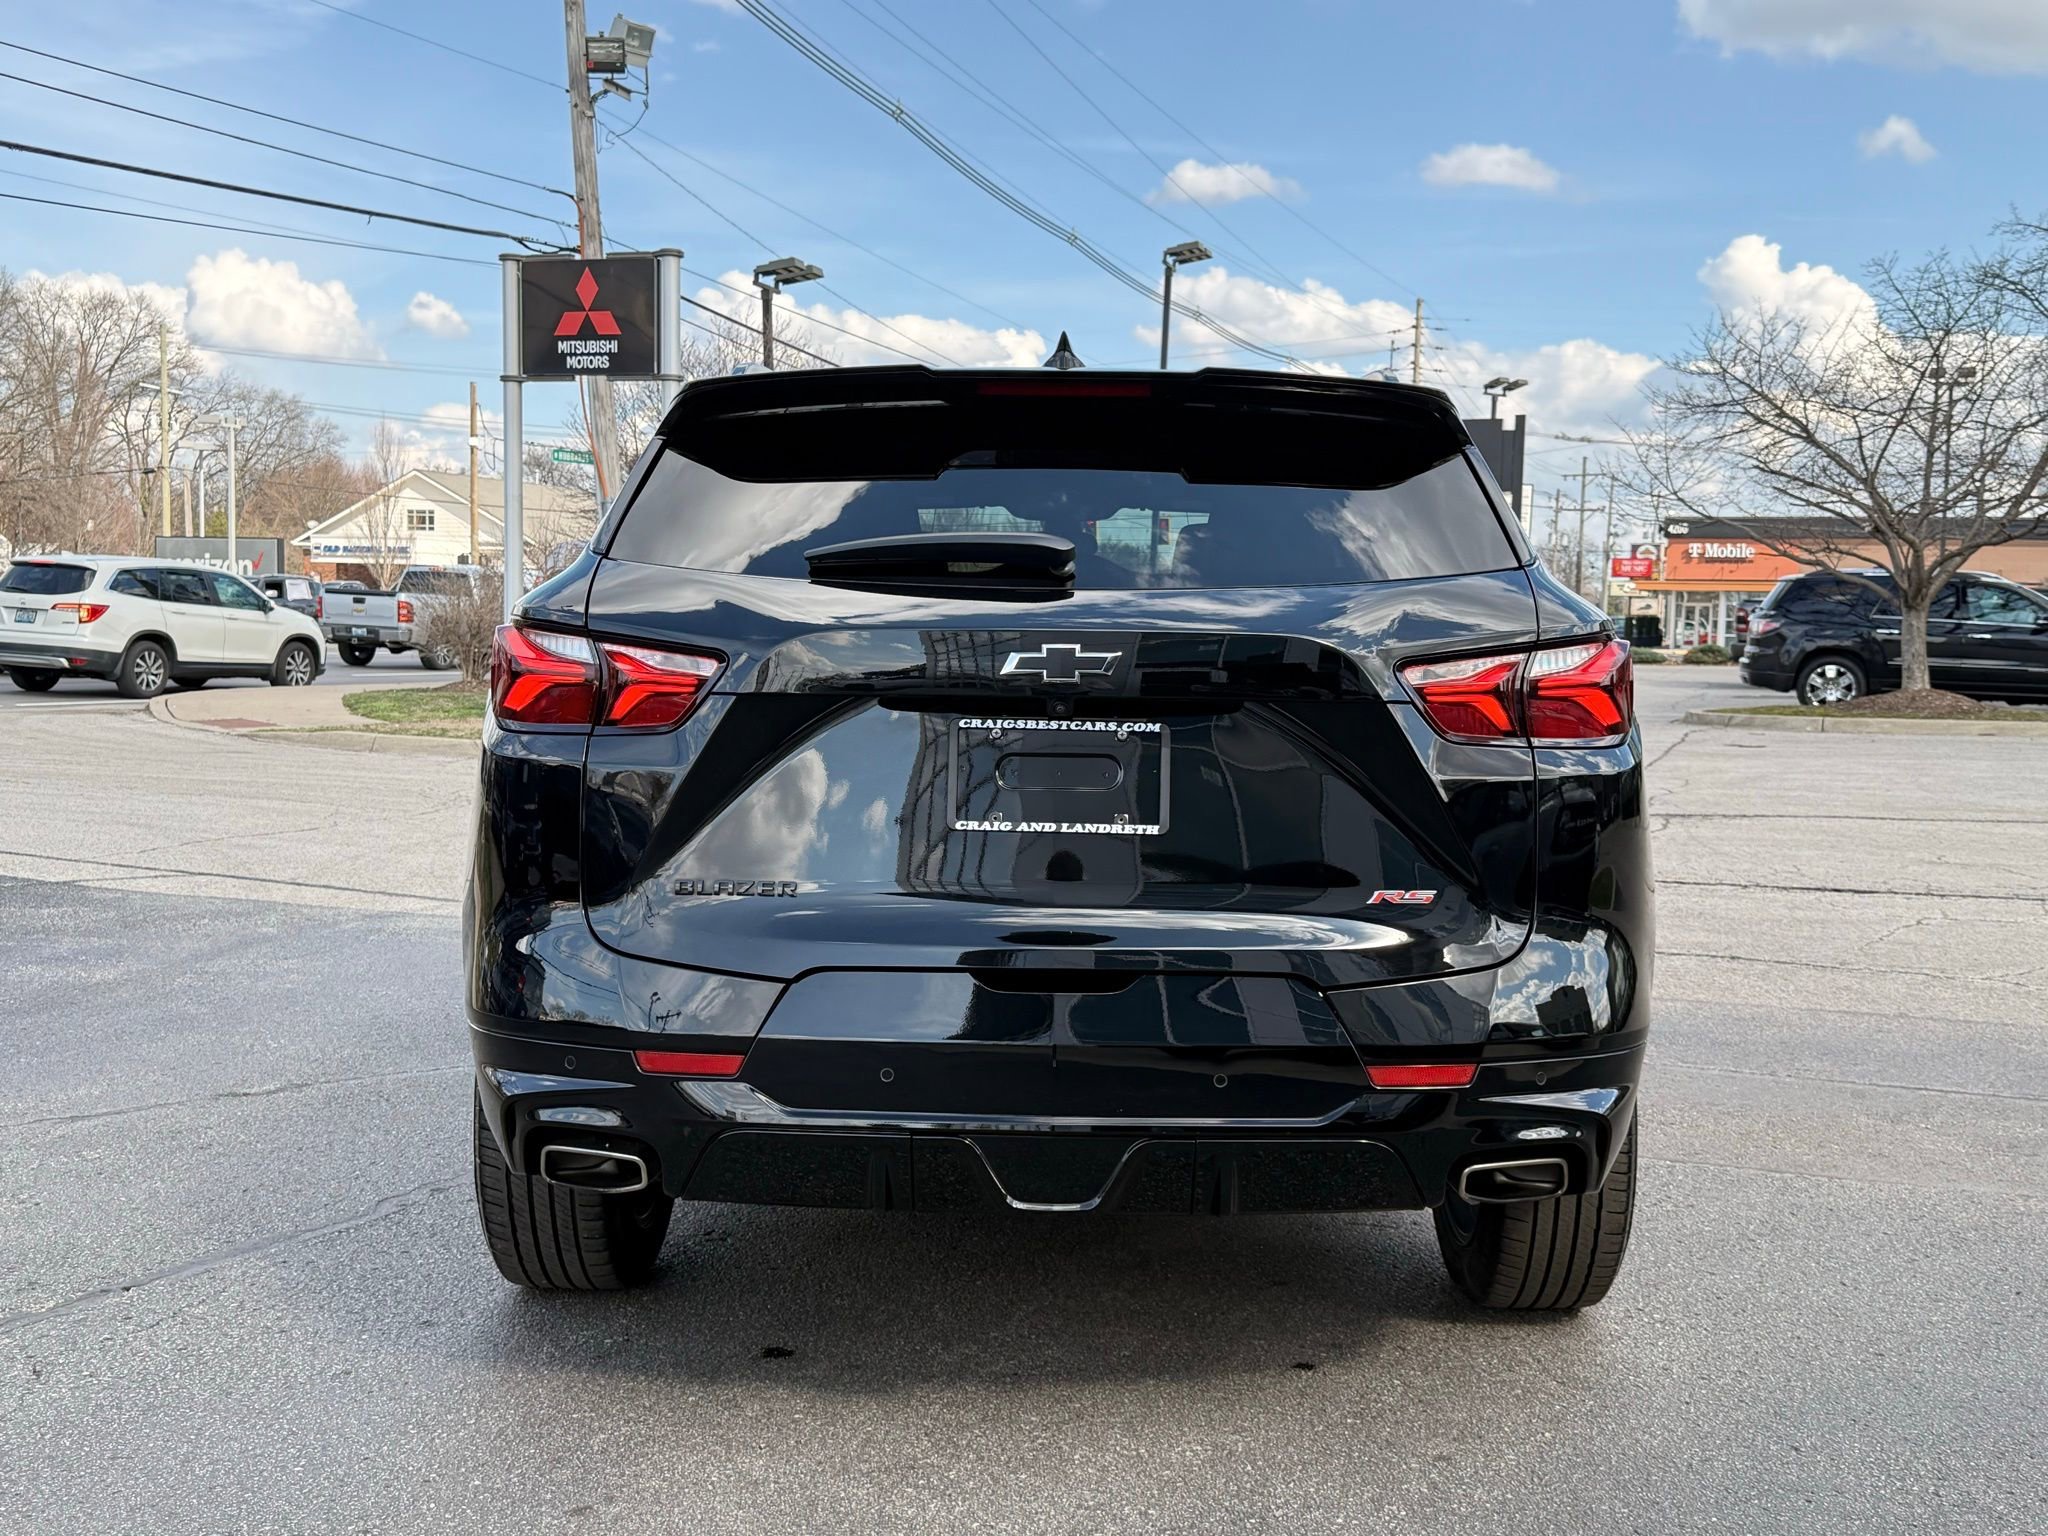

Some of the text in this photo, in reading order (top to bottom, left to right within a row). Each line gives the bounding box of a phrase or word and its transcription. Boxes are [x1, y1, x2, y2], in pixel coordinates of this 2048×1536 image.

[558, 340, 618, 354] MITSUBISHI
[566, 355, 610, 369] MOTORS
[959, 719, 1162, 732] CRAIGSBESTCARS.COM
[955, 820, 1160, 835] CRAIG AND LANDRETH
[675, 879, 798, 897] BLAZER
[1366, 890, 1438, 904] RS
